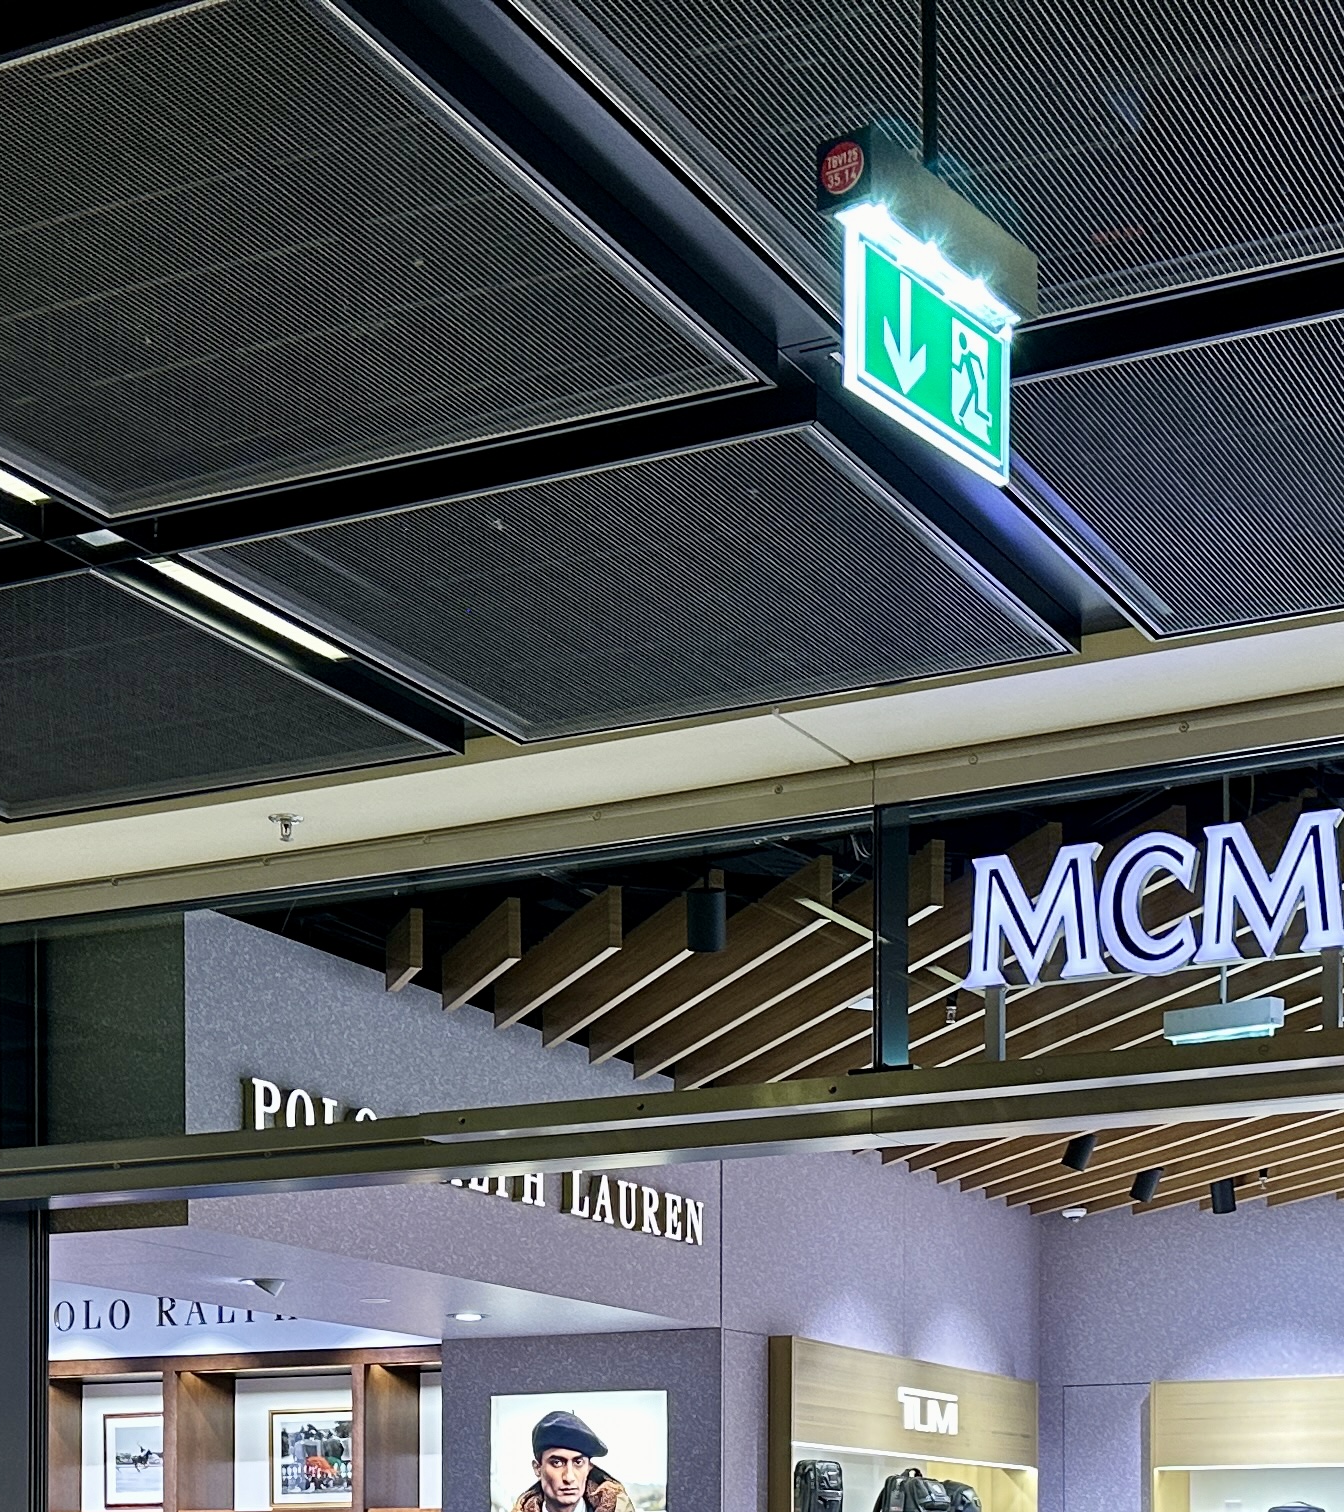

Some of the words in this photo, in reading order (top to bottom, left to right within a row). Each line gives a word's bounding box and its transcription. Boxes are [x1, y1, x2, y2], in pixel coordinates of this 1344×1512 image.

[571, 1170, 704, 1246] LAUREN
[54, 1299, 130, 1331] OLO
[156, 1296, 297, 1327] RAL
